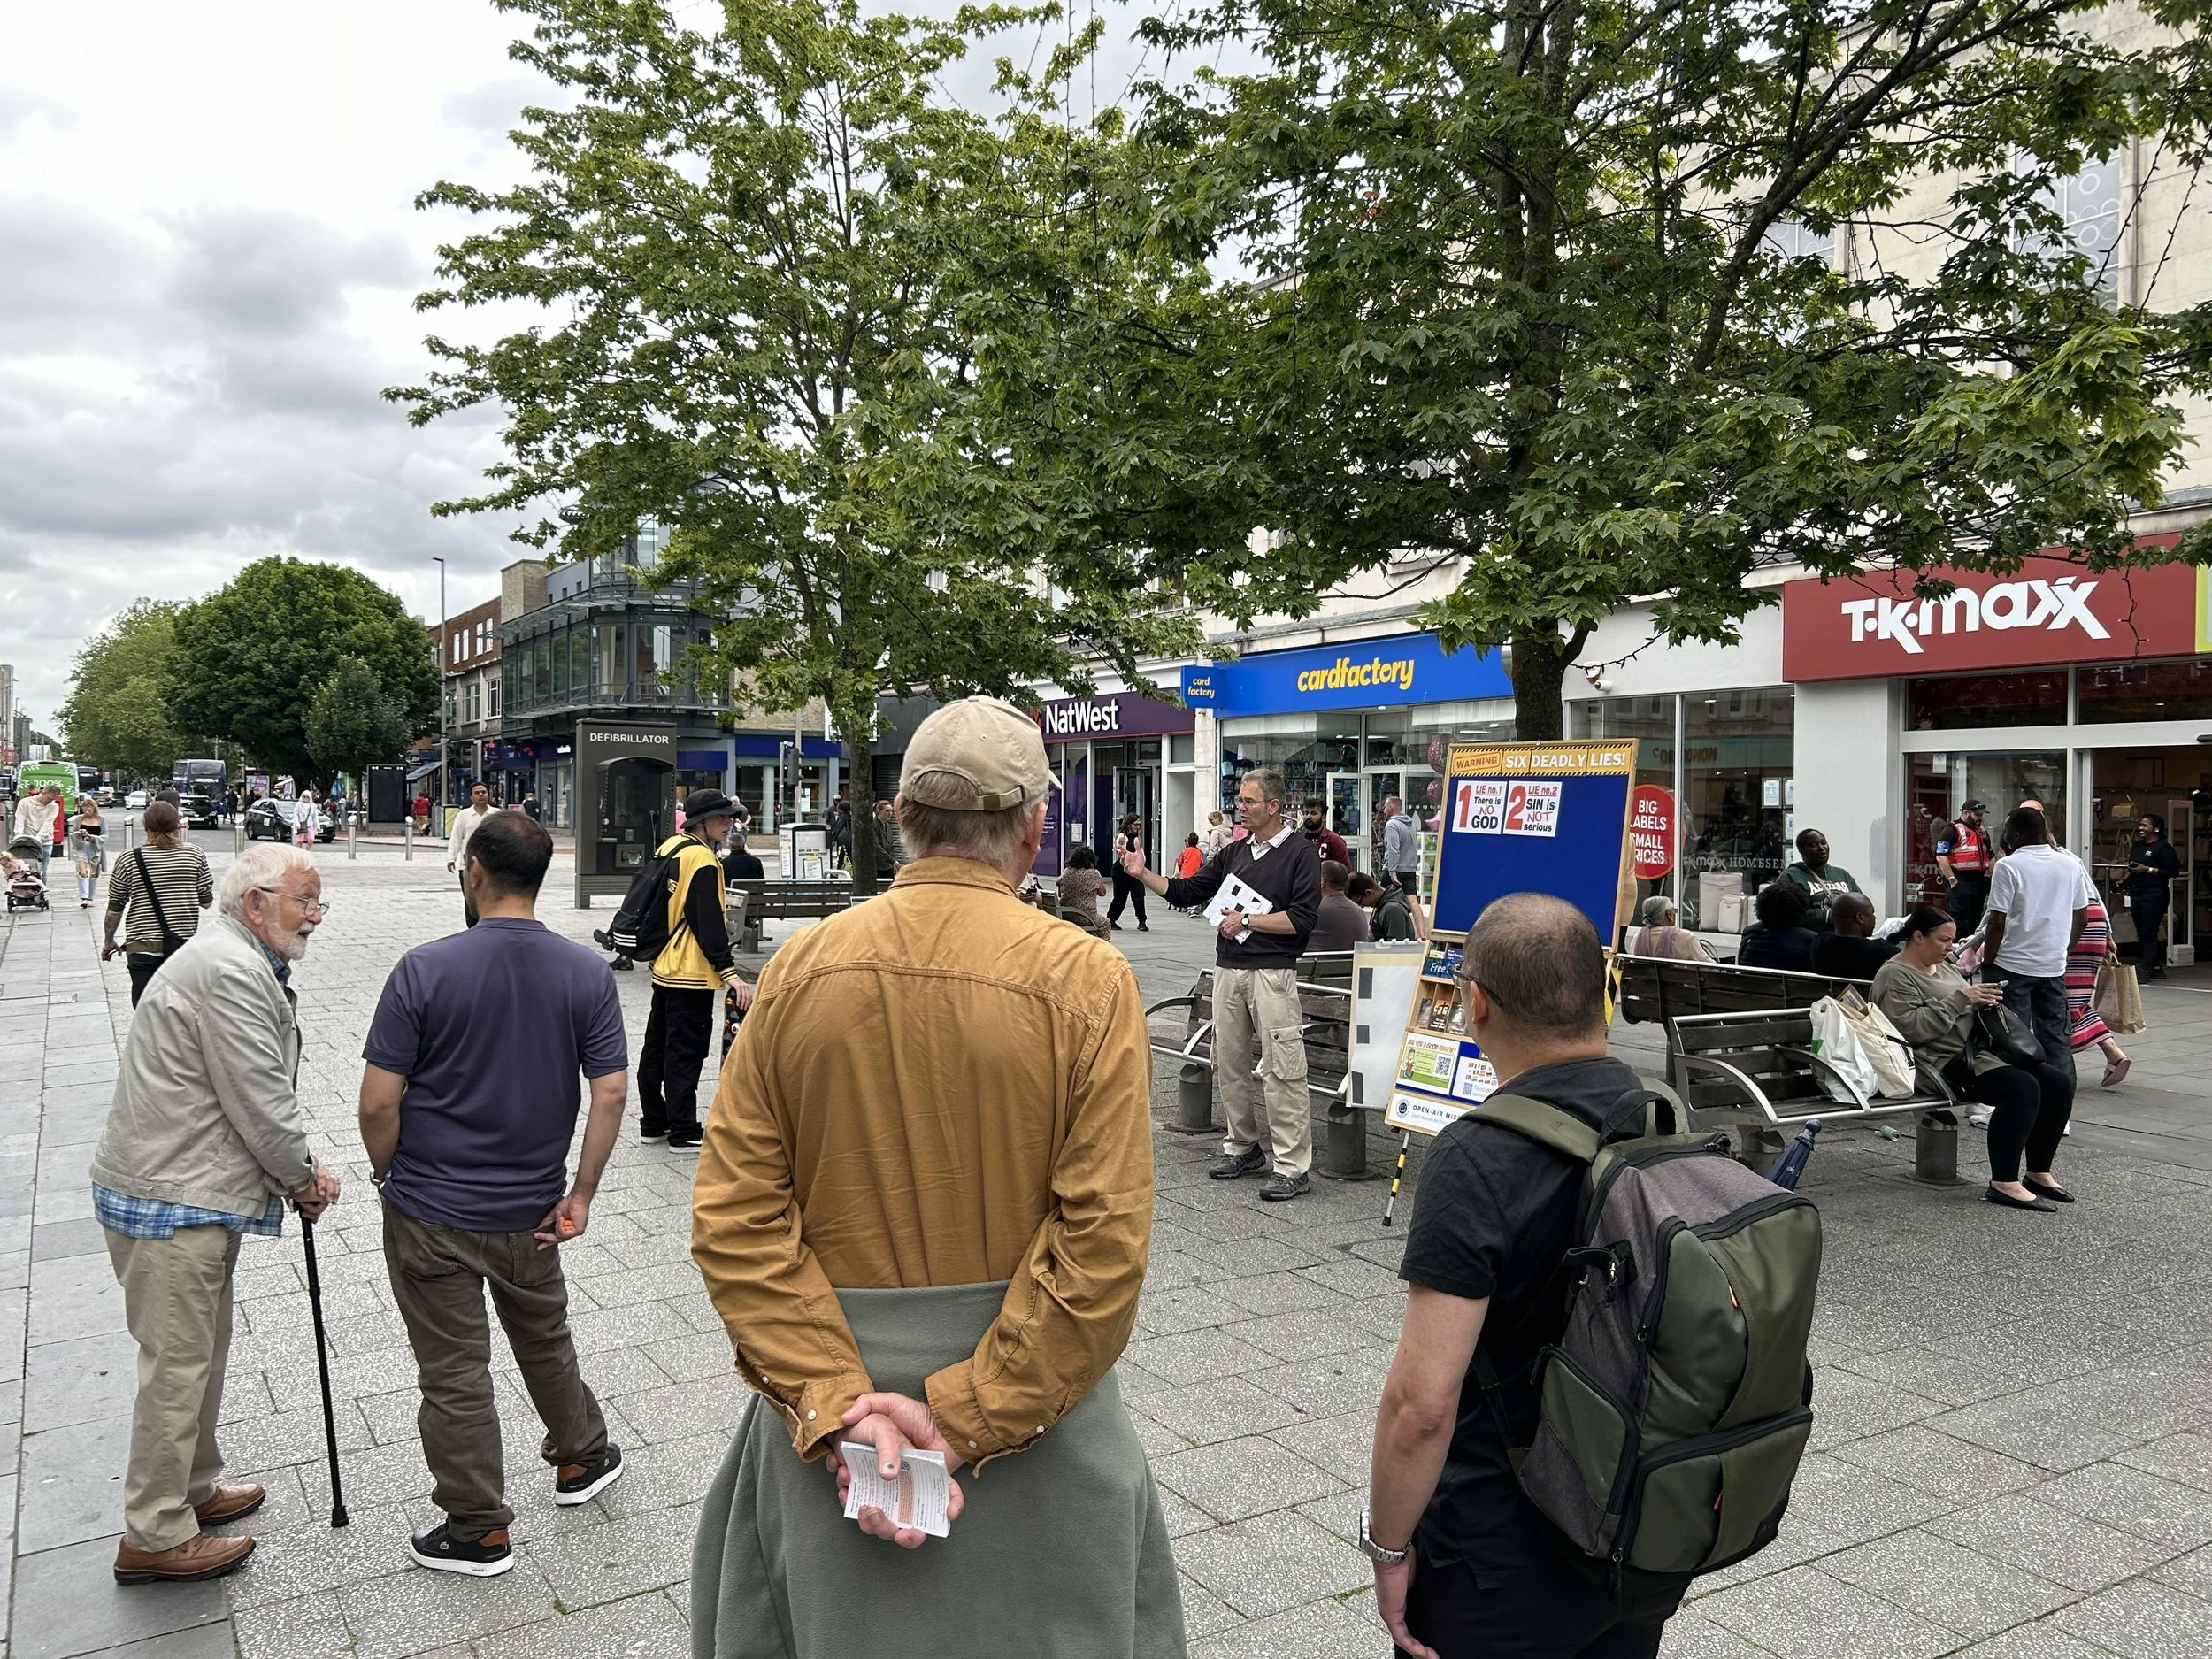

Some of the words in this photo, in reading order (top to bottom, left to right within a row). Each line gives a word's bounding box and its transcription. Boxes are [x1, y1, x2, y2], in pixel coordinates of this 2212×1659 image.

[1297, 657, 1415, 692] cardfactory
[1192, 676, 1210, 686] card
[1187, 686, 1215, 699] factory
[1046, 698, 1118, 734] NatWest
[589, 733, 669, 744] DEFIBRILLATOR
[1455, 757, 1497, 769] WARNING
[1505, 755, 1527, 768] SIX
[1531, 754, 1586, 768] DEADLY
[1590, 753, 1625, 767] LIES!
[1476, 785, 1486, 794] LIE
[1487, 786, 1502, 795] no.1
[1528, 786, 1540, 795] LIE
[1541, 786, 1557, 795] no.2
[1458, 785, 1471, 828] 1
[1474, 796, 1493, 805] There
[1526, 798, 1543, 810] SIN
[1546, 799, 1555, 810] is
[1638, 799, 1657, 814] BIG
[1479, 804, 1494, 815] NO
[1505, 786, 1526, 830] 2
[1471, 815, 1498, 829] GOD
[1527, 811, 1553, 822] NOT
[1524, 823, 1552, 832] serious
[1318, 843, 1327, 859] C
[1634, 849, 1665, 864] RICES
[1430, 962, 1446, 973] Free
[1412, 1105, 1443, 1117] OPEN-AIR
